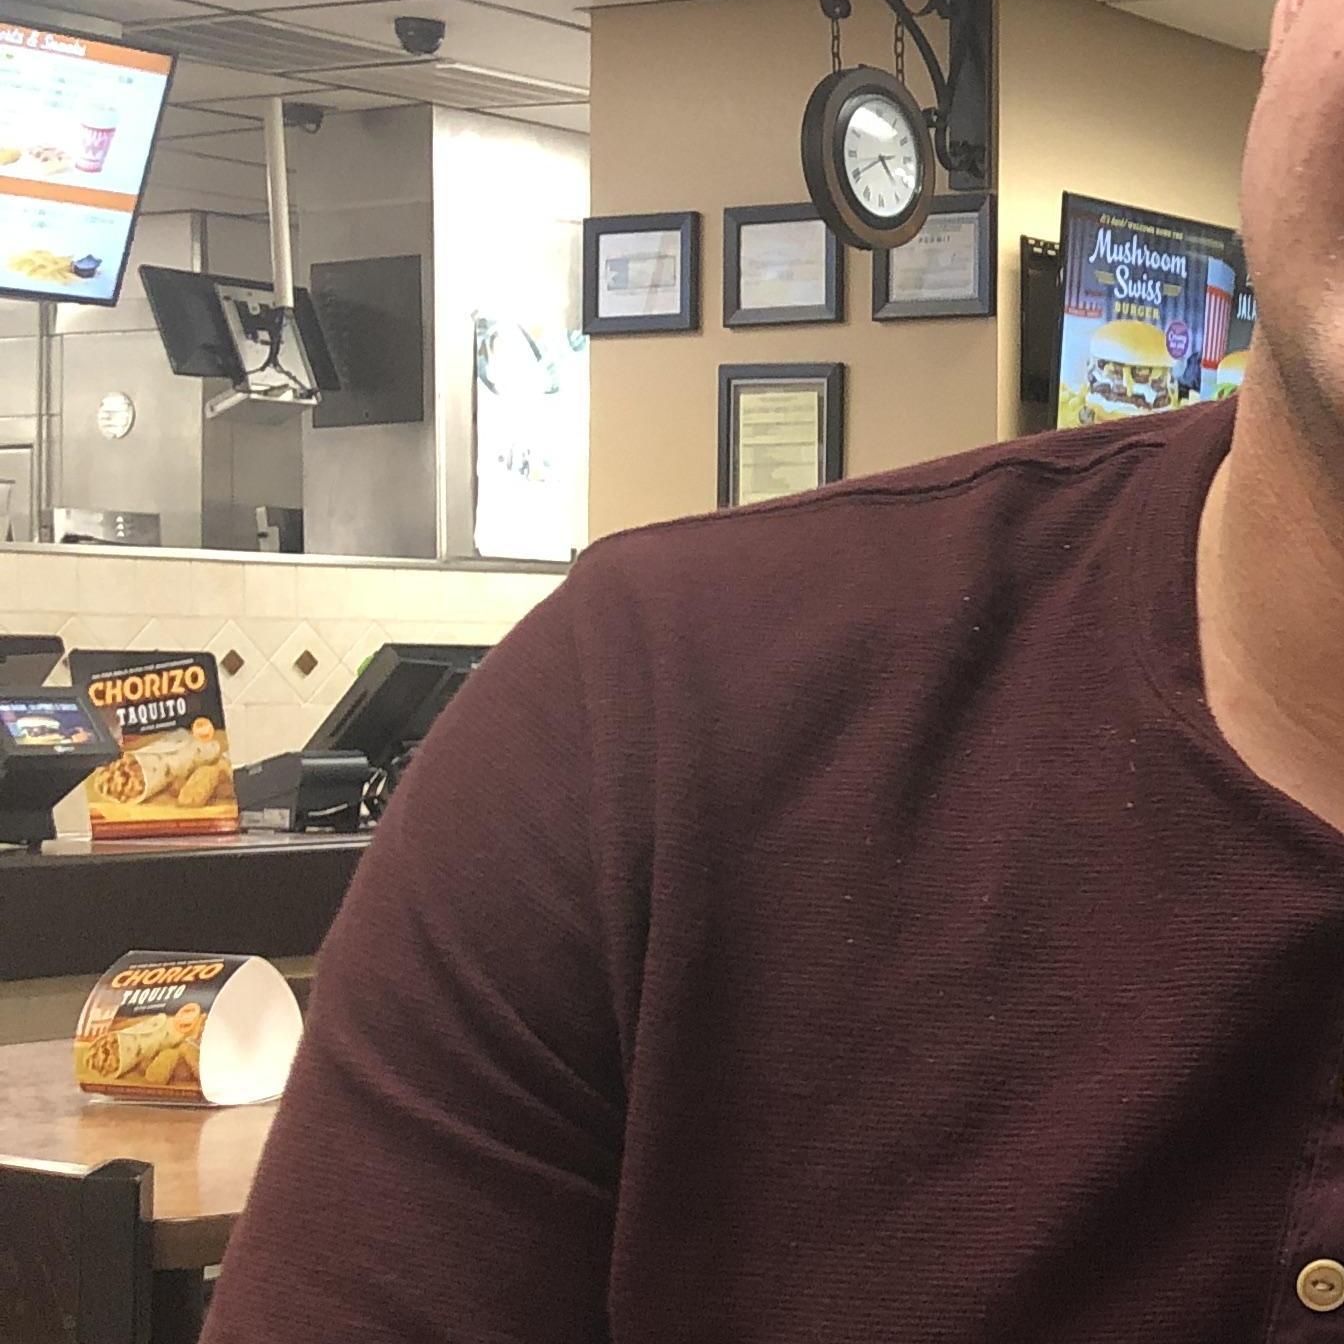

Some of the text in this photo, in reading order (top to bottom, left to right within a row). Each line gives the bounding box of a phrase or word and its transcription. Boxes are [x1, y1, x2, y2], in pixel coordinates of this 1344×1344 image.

[1089, 227, 1187, 279] Mushroom
[1114, 265, 1162, 305] Swiss
[1115, 301, 1161, 320] BURGER
[88, 665, 206, 707] CHORIZO
[116, 697, 187, 726] TAQUITO
[111, 962, 224, 988] CHORIZO
[120, 984, 187, 1006] TAQUITO
